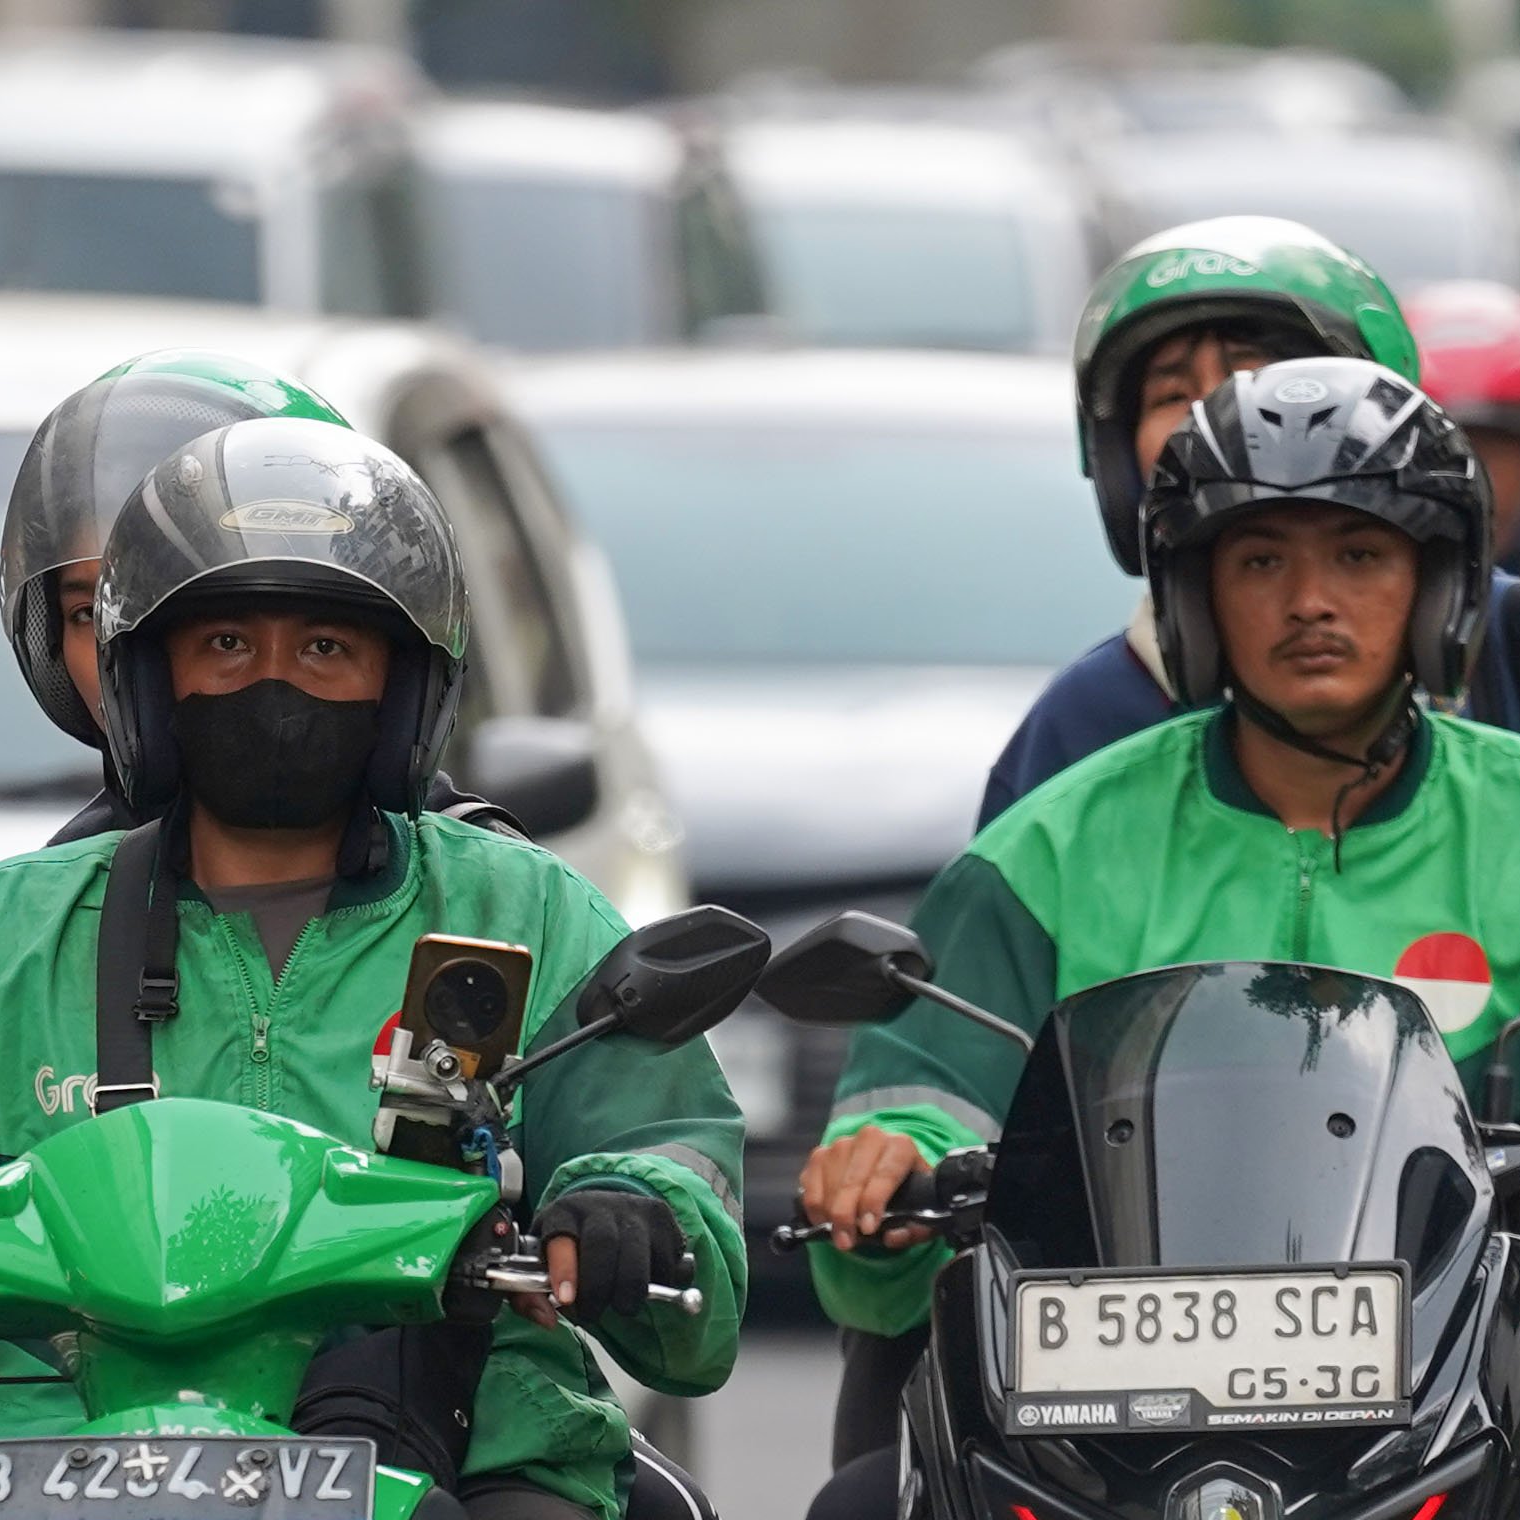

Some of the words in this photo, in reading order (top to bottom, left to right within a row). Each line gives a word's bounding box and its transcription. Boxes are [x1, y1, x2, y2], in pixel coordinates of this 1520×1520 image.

[1040, 1297, 1068, 1349] B
[1098, 1290, 1238, 1346] 5838
[1275, 1286, 1378, 1338] SCA
[1040, 1404, 1118, 1425] YAMAHA
[1207, 1411, 1299, 1426] SEMAKIN
[1323, 1408, 1394, 1421] DEPAN
